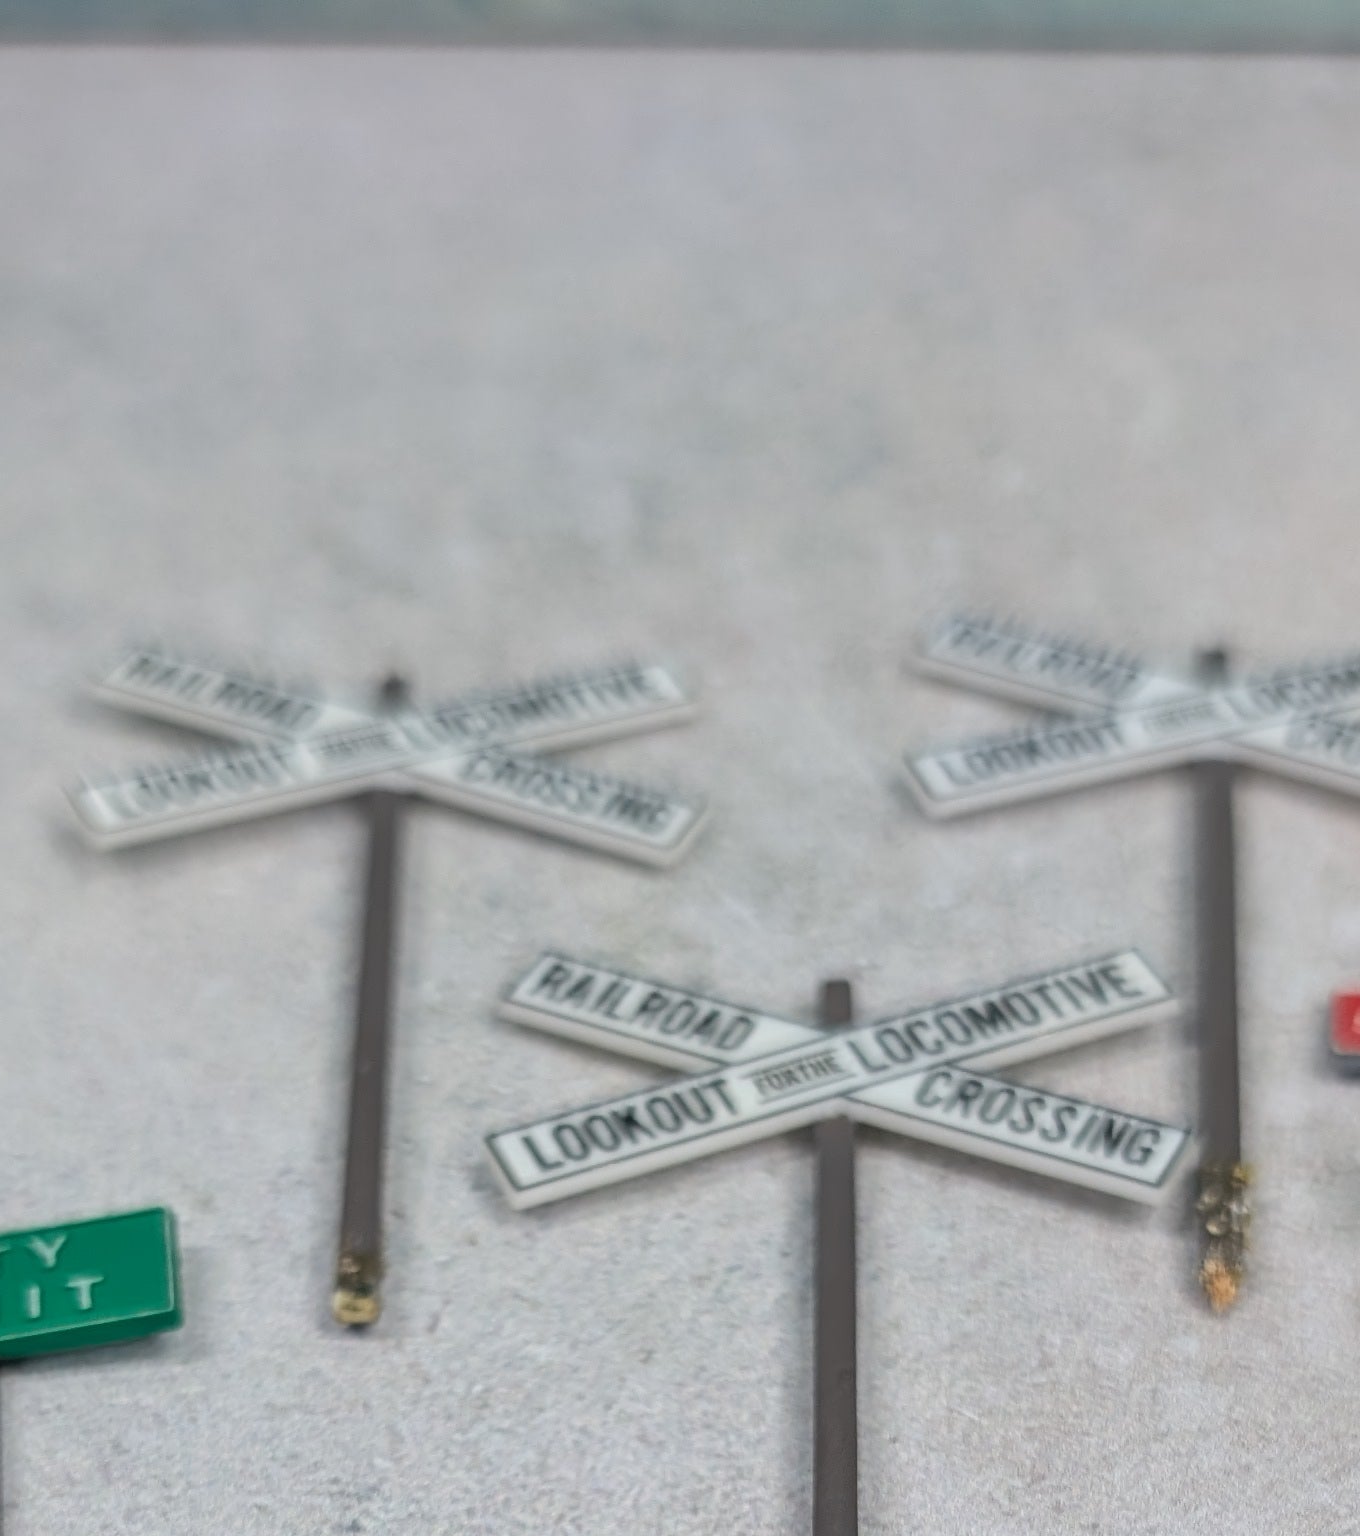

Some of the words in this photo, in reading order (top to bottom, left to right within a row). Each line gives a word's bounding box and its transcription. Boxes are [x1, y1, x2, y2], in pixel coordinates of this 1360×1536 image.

[532, 958, 757, 1053] RAILROAD
[520, 1077, 746, 1173] LOOKOUT
[848, 962, 1139, 1077] LOCOMOTIVE
[913, 1064, 1170, 1169] CROSSING
